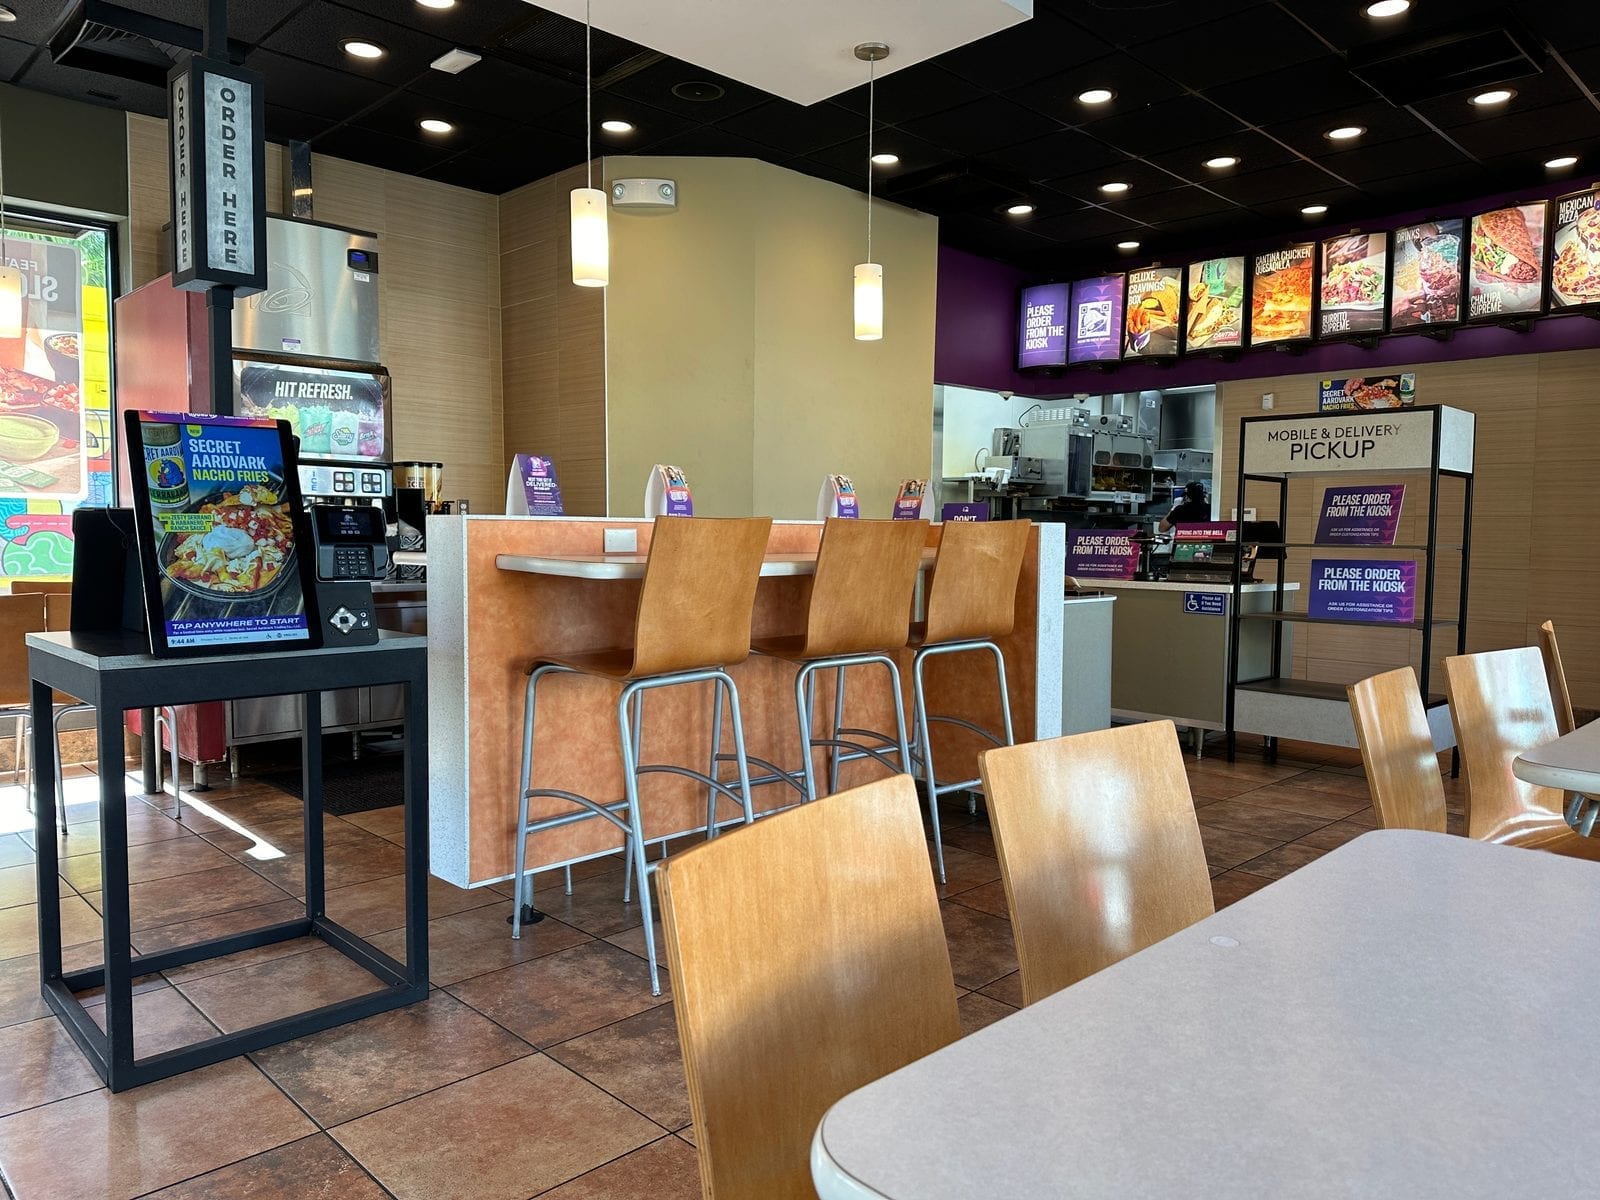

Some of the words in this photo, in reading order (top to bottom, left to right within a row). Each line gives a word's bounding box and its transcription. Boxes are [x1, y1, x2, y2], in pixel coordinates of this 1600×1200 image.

[177, 87, 186, 178] ORDER
[220, 87, 236, 179] ORDER
[1559, 196, 1594, 214] MEXICAN
[1559, 210, 1579, 225] PIZZA
[180, 192, 188, 263] HERE
[222, 191, 237, 265] HERE
[1397, 228, 1420, 243] DRINKS
[1255, 251, 1280, 266] CANTINA
[1280, 248, 1311, 260] CHICKEN
[1256, 259, 1291, 275] QUESADILLA
[1129, 270, 1156, 284] DELUXE
[1129, 280, 1166, 294] CRAVINGS
[1128, 294, 1143, 306] BOX
[1471, 293, 1502, 307] CHALUPA
[1027, 304, 1055, 318] PLEASE
[1470, 301, 1502, 316] SUPREME
[1027, 316, 1052, 329] ORDER
[1322, 311, 1348, 324] BURRITO
[1026, 327, 1047, 340] FROM
[1047, 325, 1065, 338] THE
[1322, 320, 1351, 334] SUPREME
[1025, 338, 1048, 350] KIOSK
[275, 381, 297, 398] HIT
[298, 383, 354, 400] REFRESH.
[1322, 389, 1345, 398] SECRET
[1322, 396, 1355, 405] AARDVARK
[1268, 428, 1317, 442] MOBILE
[1321, 428, 1330, 439] &
[1335, 423, 1402, 439] DELIVERY
[188, 438, 241, 454] SECRET
[1290, 439, 1376, 461] PICKUP
[191, 454, 267, 470] AARDVARK
[193, 469, 235, 481] NACHO
[238, 470, 269, 483] FRIES
[1332, 494, 1362, 506] PLEASE
[1362, 493, 1391, 505] ORDER
[1326, 506, 1349, 517] FROM
[1350, 506, 1365, 517] THE
[1366, 505, 1394, 517] KIOSK
[1077, 536, 1104, 546] PLEASE
[1072, 545, 1093, 555] FROM
[1094, 546, 1109, 555] THE
[1110, 546, 1133, 556] KIOSK
[1324, 568, 1362, 579] PLEASE
[1365, 568, 1401, 580] ORDER
[1318, 579, 1348, 591] FROM
[1350, 580, 1370, 591] THE
[1372, 581, 1406, 593] KIOSK
[194, 620, 253, 629] ANYWHERE
[270, 617, 300, 625] START
